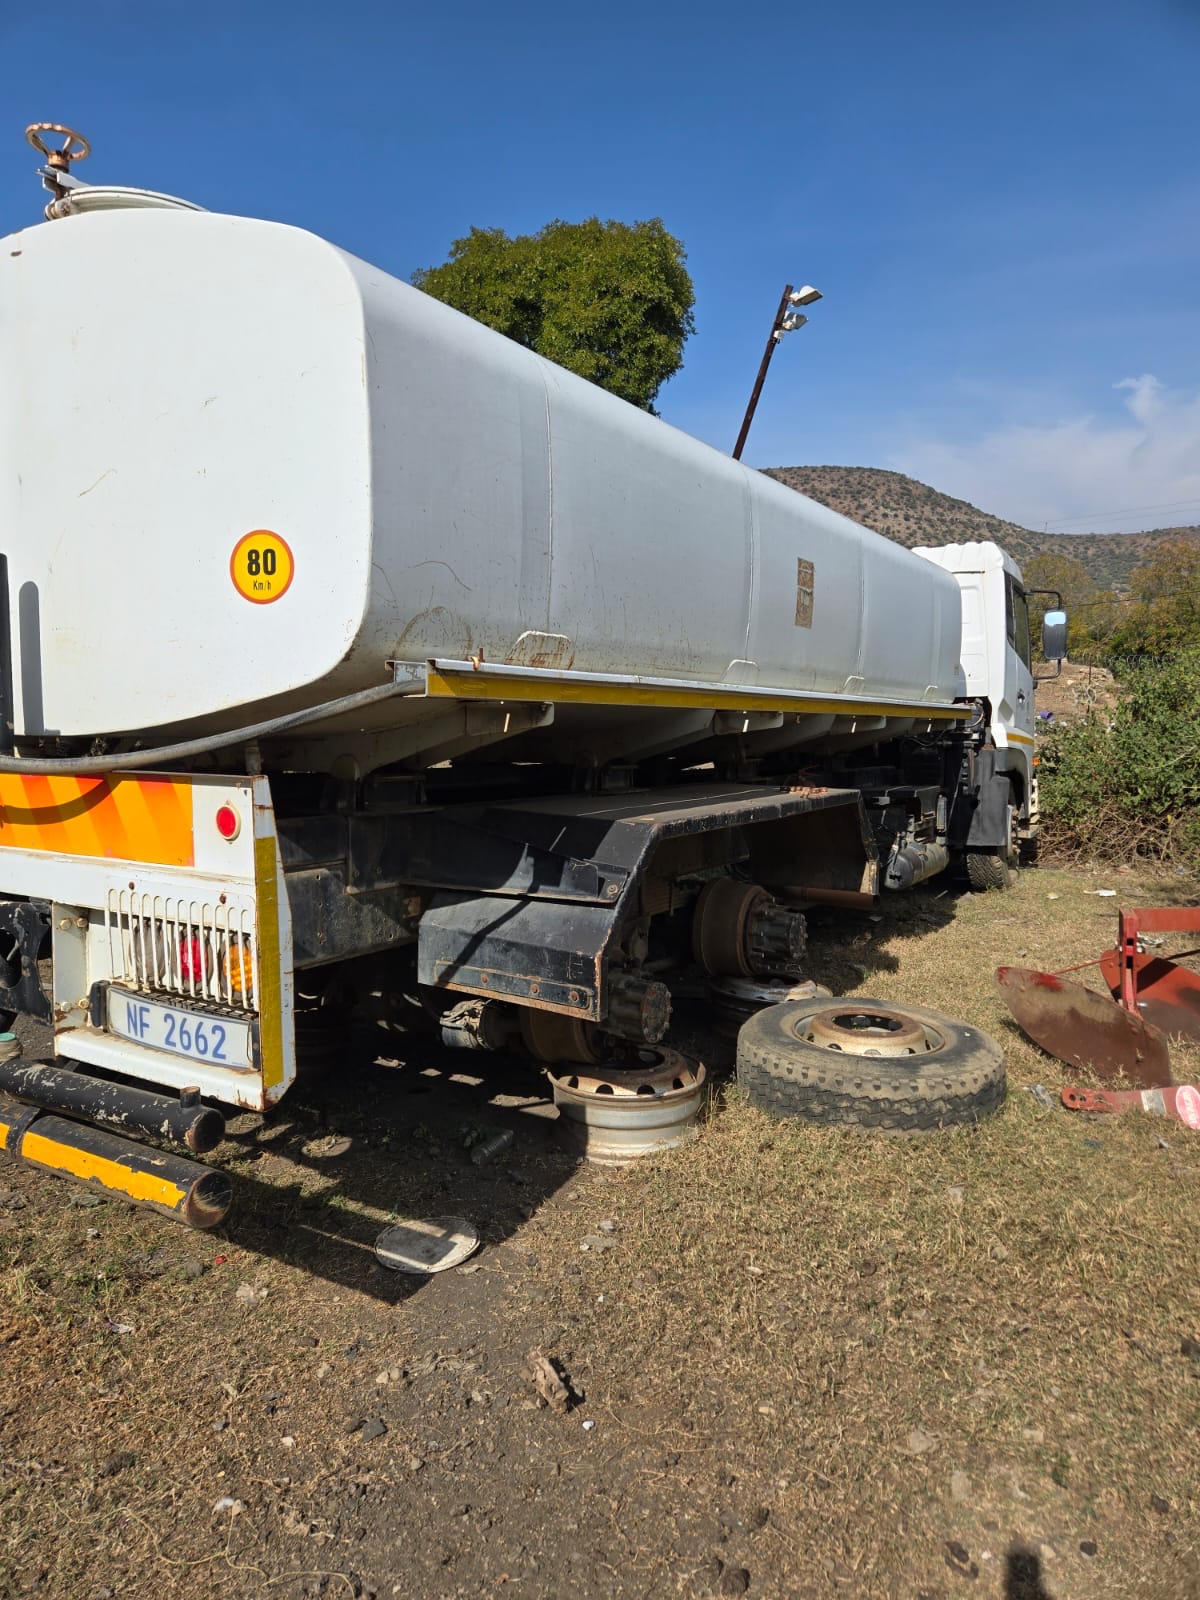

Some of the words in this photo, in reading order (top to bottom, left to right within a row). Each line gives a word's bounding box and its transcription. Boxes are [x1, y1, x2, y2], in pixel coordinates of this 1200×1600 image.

[247, 548, 276, 576] 80
[253, 580, 272, 591] Km/h
[126, 1002, 150, 1038] NF
[163, 1013, 227, 1060] 2662
